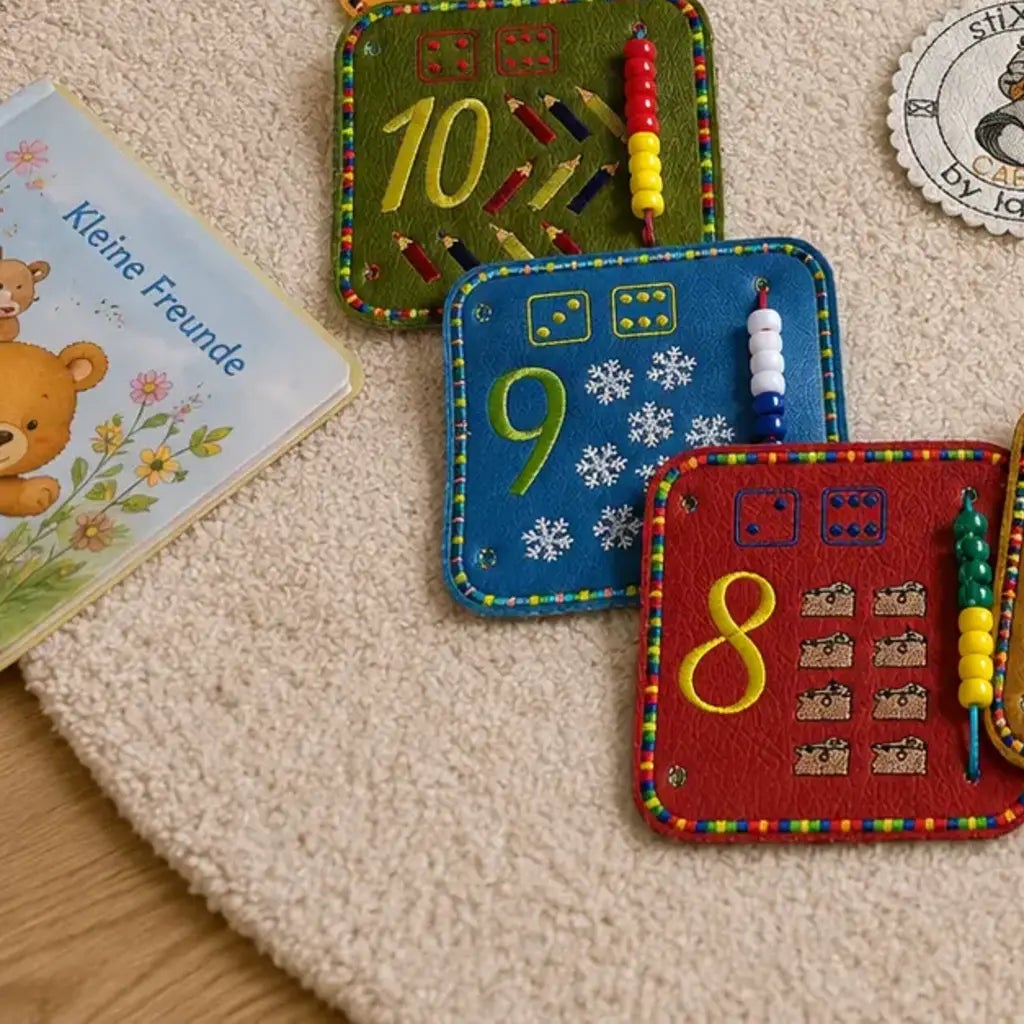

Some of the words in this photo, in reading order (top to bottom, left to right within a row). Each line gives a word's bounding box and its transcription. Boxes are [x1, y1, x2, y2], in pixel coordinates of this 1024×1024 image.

[381, 96, 491, 213] 10
[940, 162, 983, 198] by
[61, 199, 147, 281] Kleine
[138, 274, 247, 377] Freunde
[487, 367, 568, 497] 9
[678, 571, 776, 714] 8
